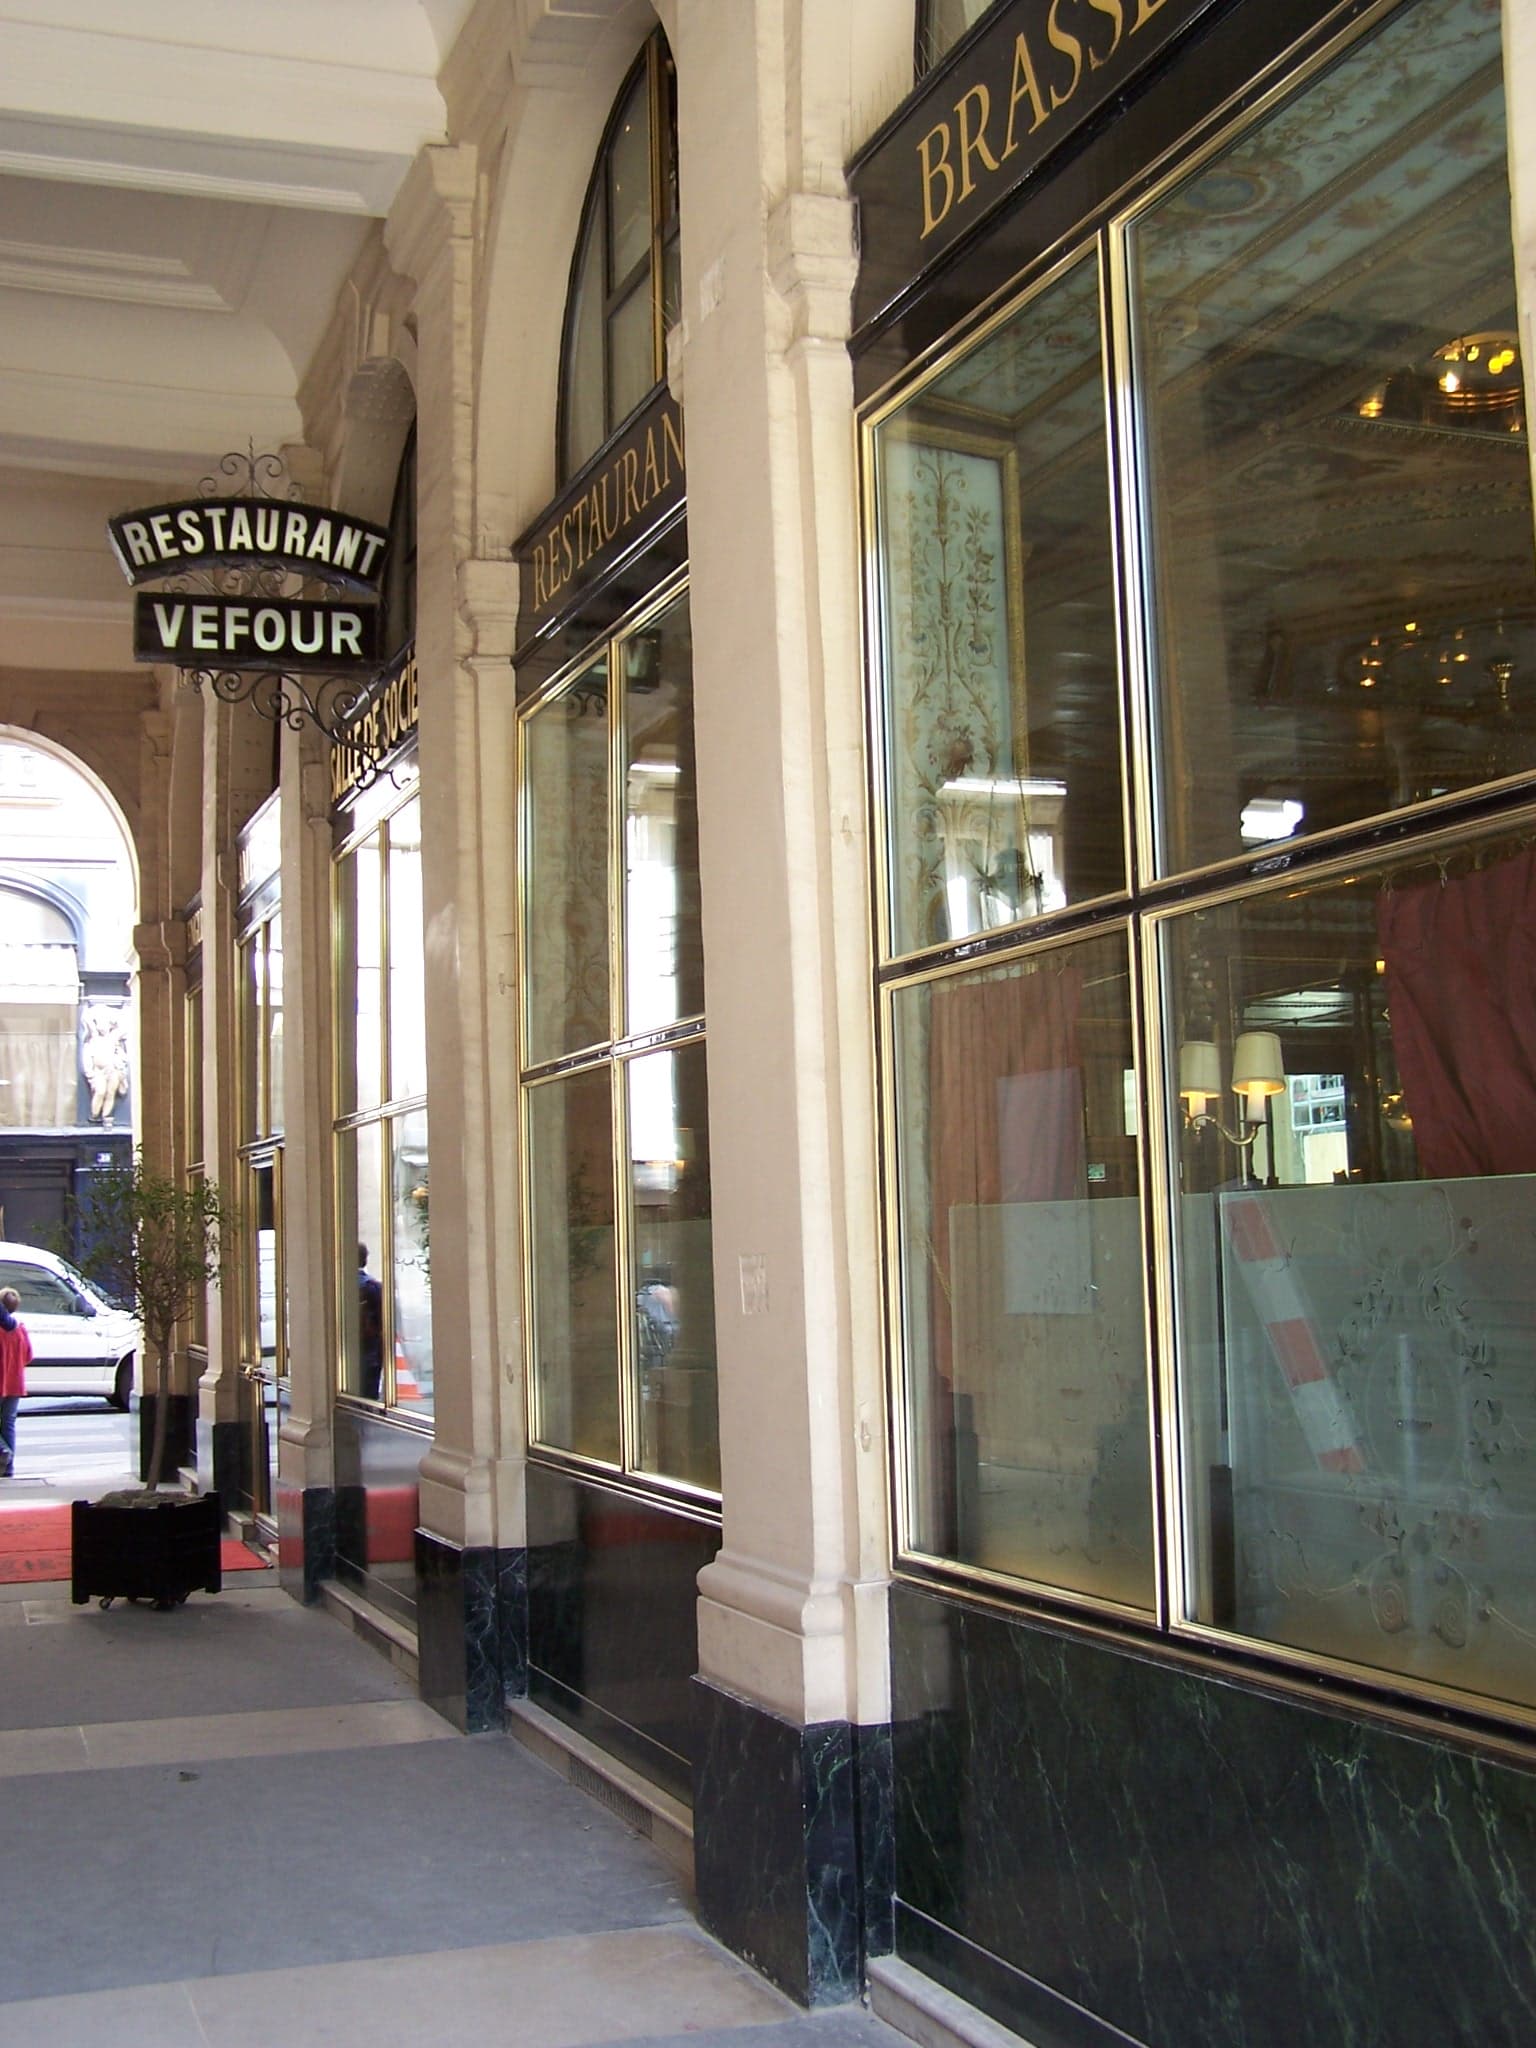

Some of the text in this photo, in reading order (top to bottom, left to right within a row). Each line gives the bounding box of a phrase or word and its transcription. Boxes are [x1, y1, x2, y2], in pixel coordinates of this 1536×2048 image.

[916, 0, 1168, 240] BRASS
[122, 507, 385, 575] RESTAURANT
[153, 603, 363, 656] VEFOUR
[330, 720, 362, 803] SALLE
[363, 698, 380, 770] DE
